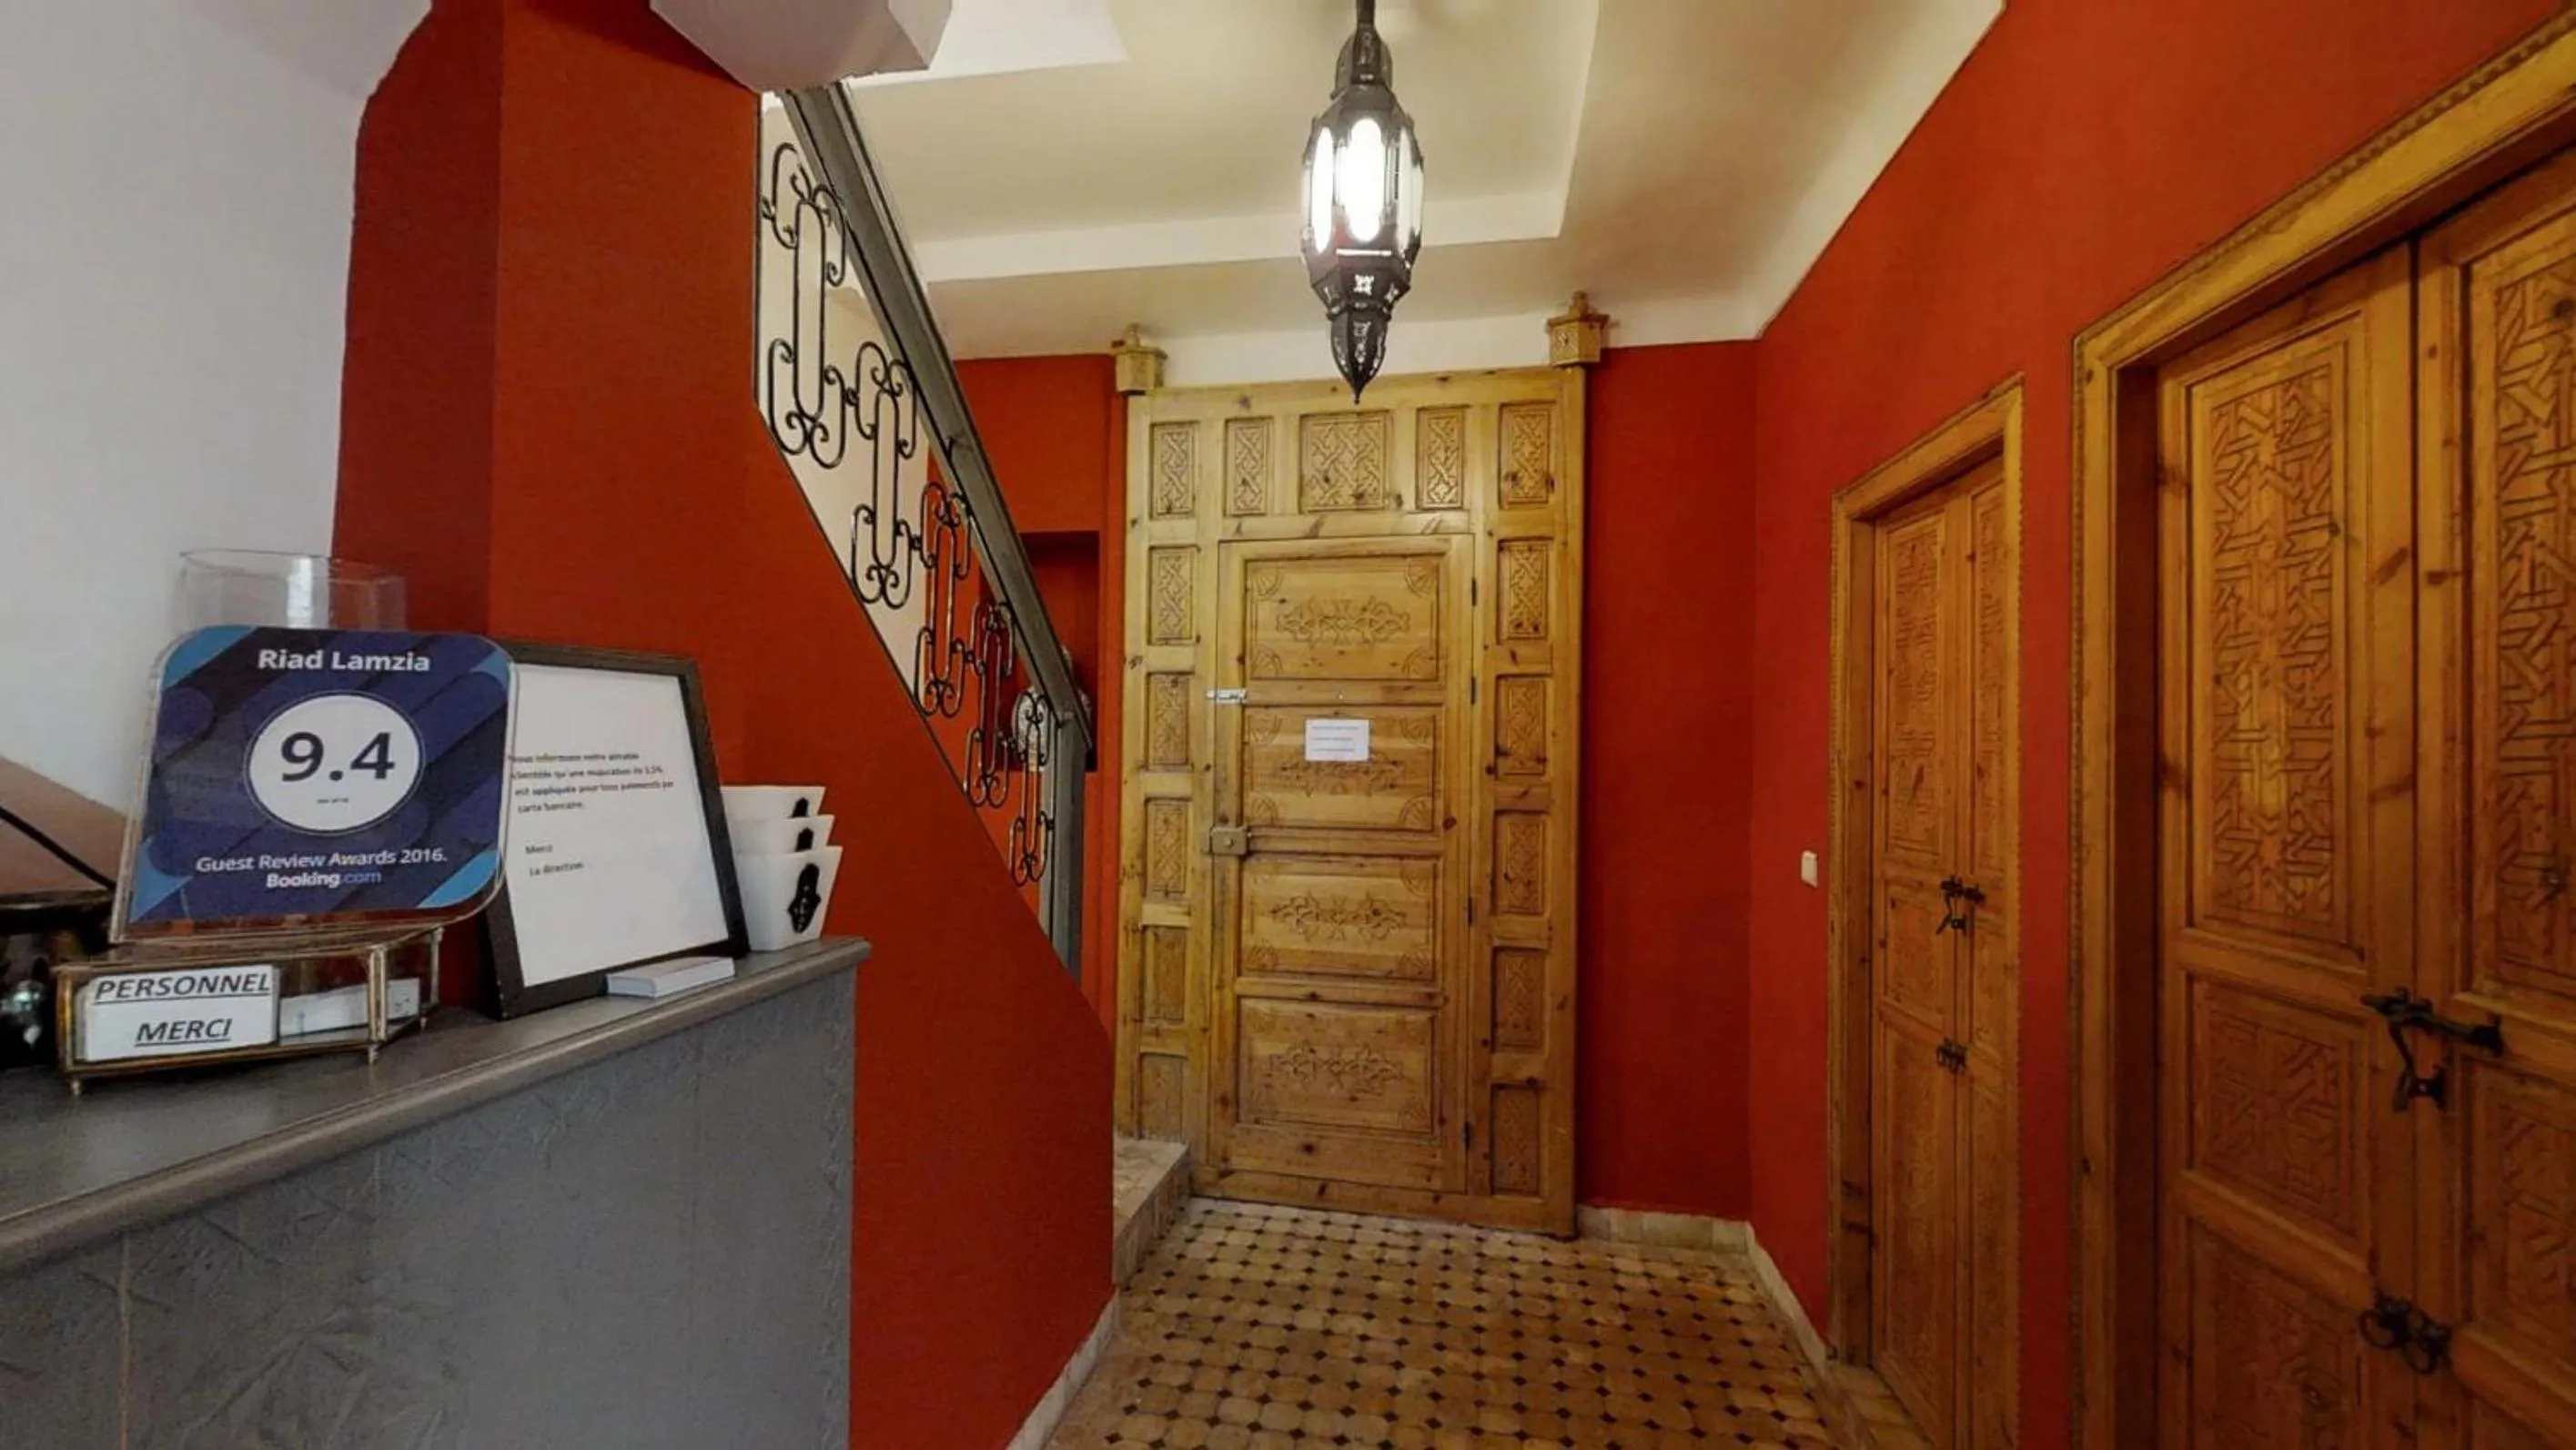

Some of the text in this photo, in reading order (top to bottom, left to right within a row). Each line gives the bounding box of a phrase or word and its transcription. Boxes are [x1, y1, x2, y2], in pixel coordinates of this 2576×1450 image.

[258, 649, 430, 672] Riad Lamzia
[280, 731, 396, 783] 9.4
[196, 847, 448, 872] Guest Review Awards 2016.
[267, 870, 382, 888] Booking.com
[96, 973, 270, 1000] PERSONNEL
[136, 1019, 233, 1042] MERCI
